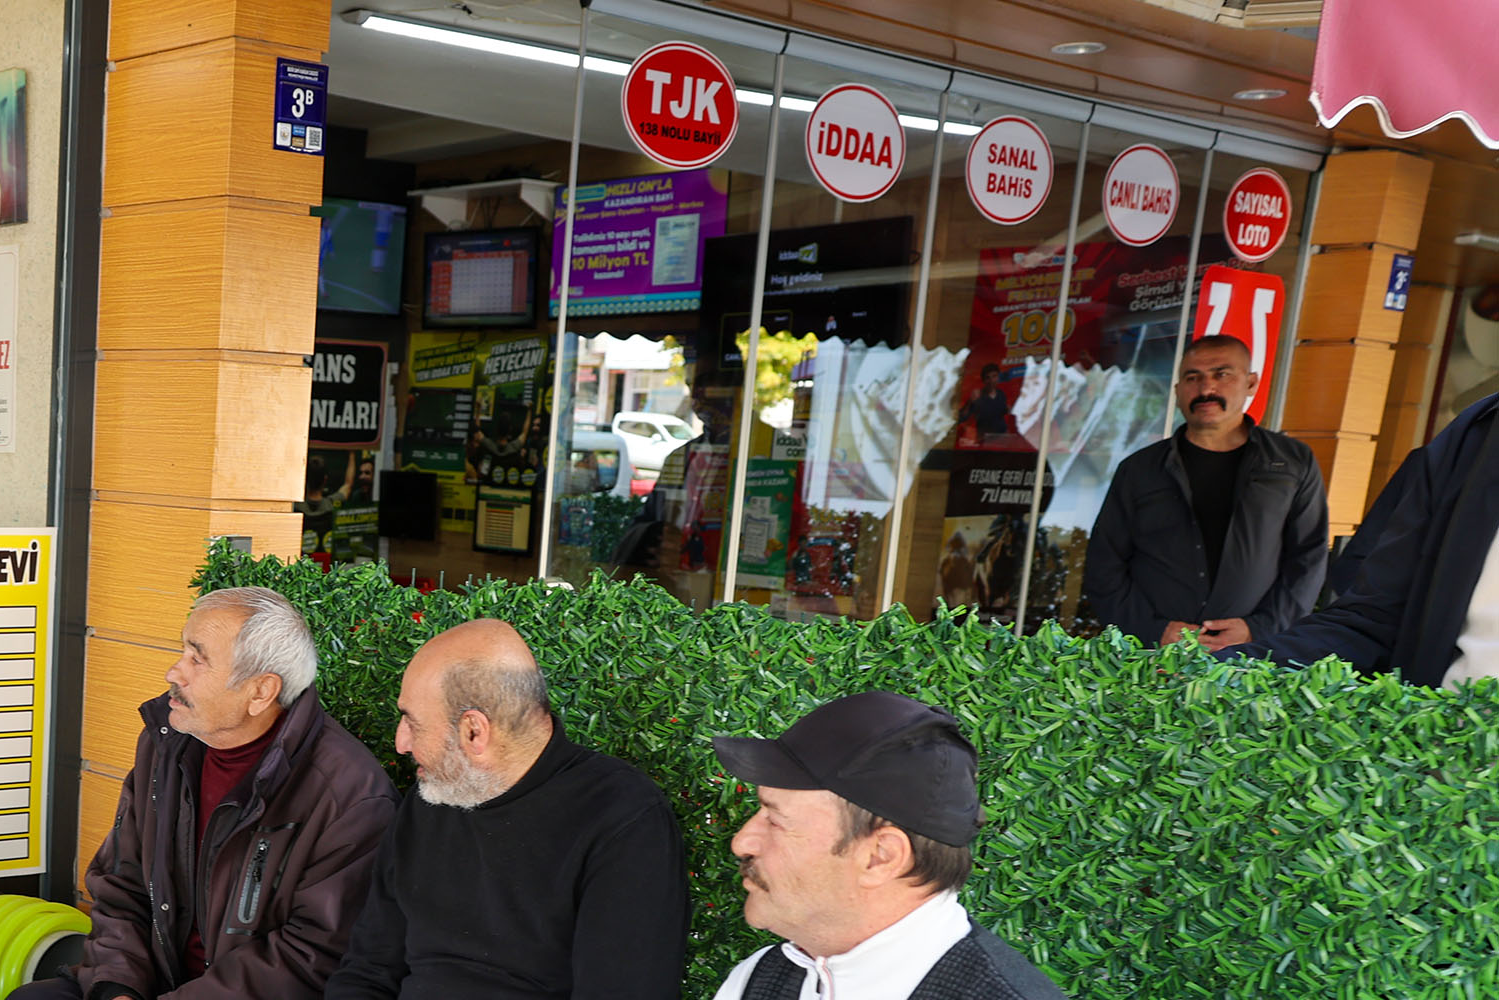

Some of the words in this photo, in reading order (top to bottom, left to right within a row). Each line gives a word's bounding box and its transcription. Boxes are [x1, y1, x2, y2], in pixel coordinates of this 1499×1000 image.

[291, 87, 314, 118] 3B
[645, 68, 724, 125] TJK
[639, 121, 659, 136] 138
[661, 125, 691, 141] NOLU
[987, 143, 1038, 171] SANAL
[1110, 179, 1142, 209] CANLI
[1234, 190, 1284, 219] SAYISAL
[1237, 223, 1270, 248] LOTO
[572, 257, 586, 271] 10
[587, 253, 631, 271] Milyon
[631, 251, 649, 267] TL
[1134, 279, 1176, 300] Şimdi
[1001, 306, 1077, 348] 100
[303, 352, 356, 384] ANS
[483, 348, 546, 376] HEYECANI
[311, 398, 378, 430] NLARI
